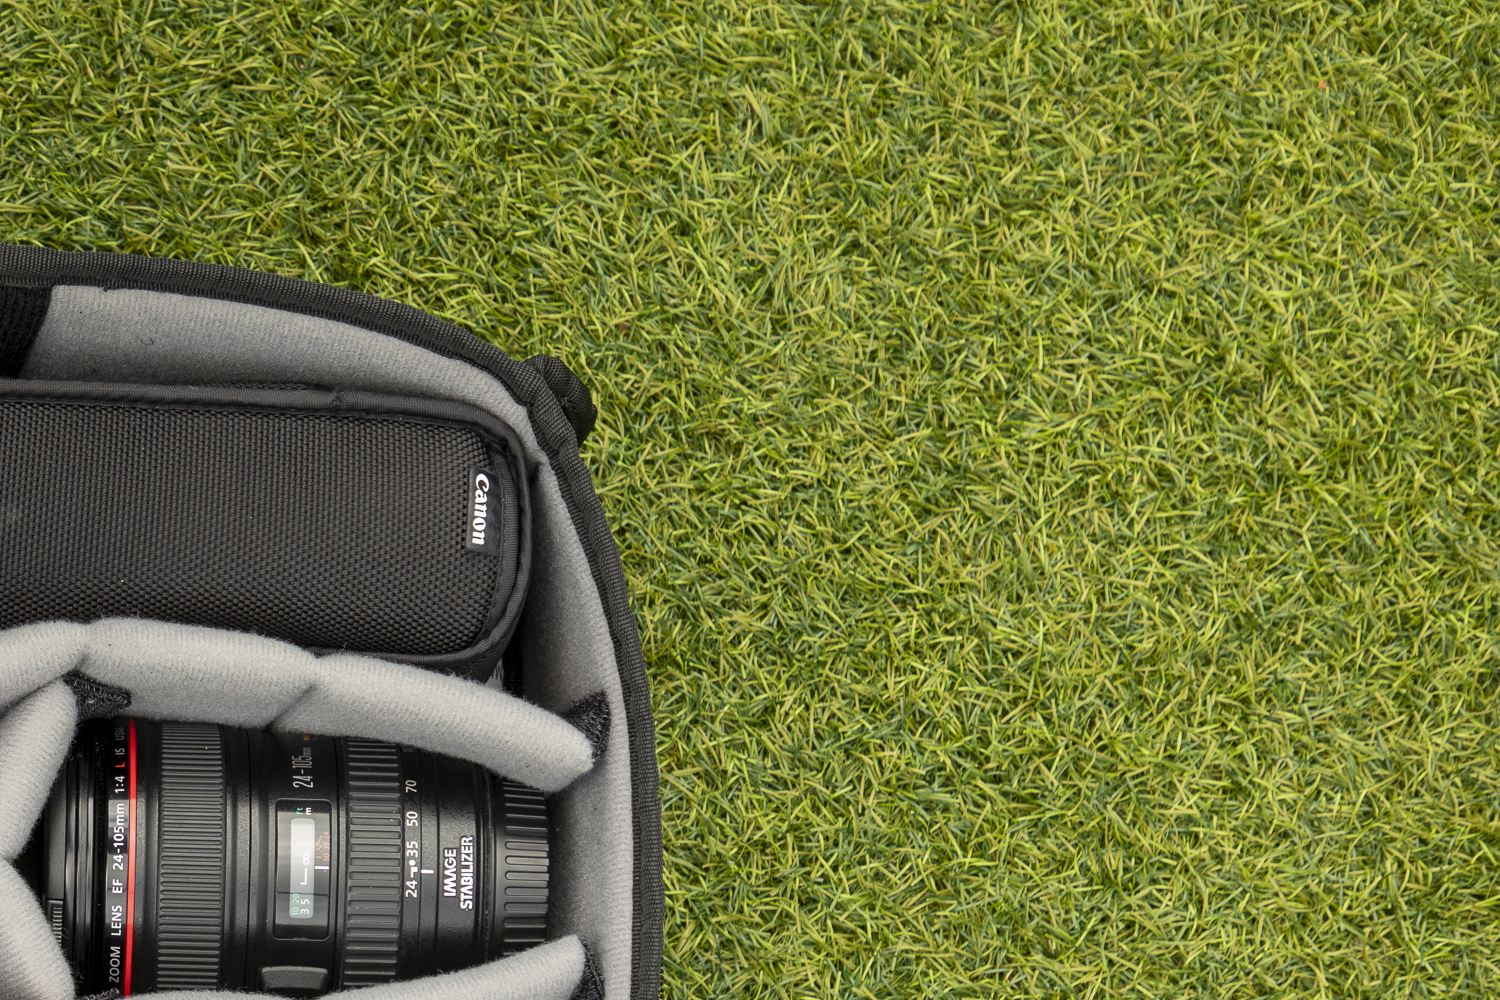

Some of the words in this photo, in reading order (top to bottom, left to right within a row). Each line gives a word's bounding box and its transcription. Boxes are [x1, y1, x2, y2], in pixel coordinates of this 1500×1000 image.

[472, 474, 490, 545] Canon
[114, 775, 125, 793] 1:4
[405, 780, 417, 793] 70
[306, 807, 312, 815] m
[406, 811, 418, 827] 50
[112, 803, 125, 870] 24-105mm
[406, 840, 418, 858] 35
[444, 849, 456, 897] IMAGE
[460, 836, 474, 910] STABILIZER
[112, 879, 123, 894] EF
[406, 880, 418, 898] 24
[292, 893, 300, 904] 20
[111, 905, 122, 936] LENS
[292, 907, 299, 916] 10
[109, 946, 120, 983] ZOOM
